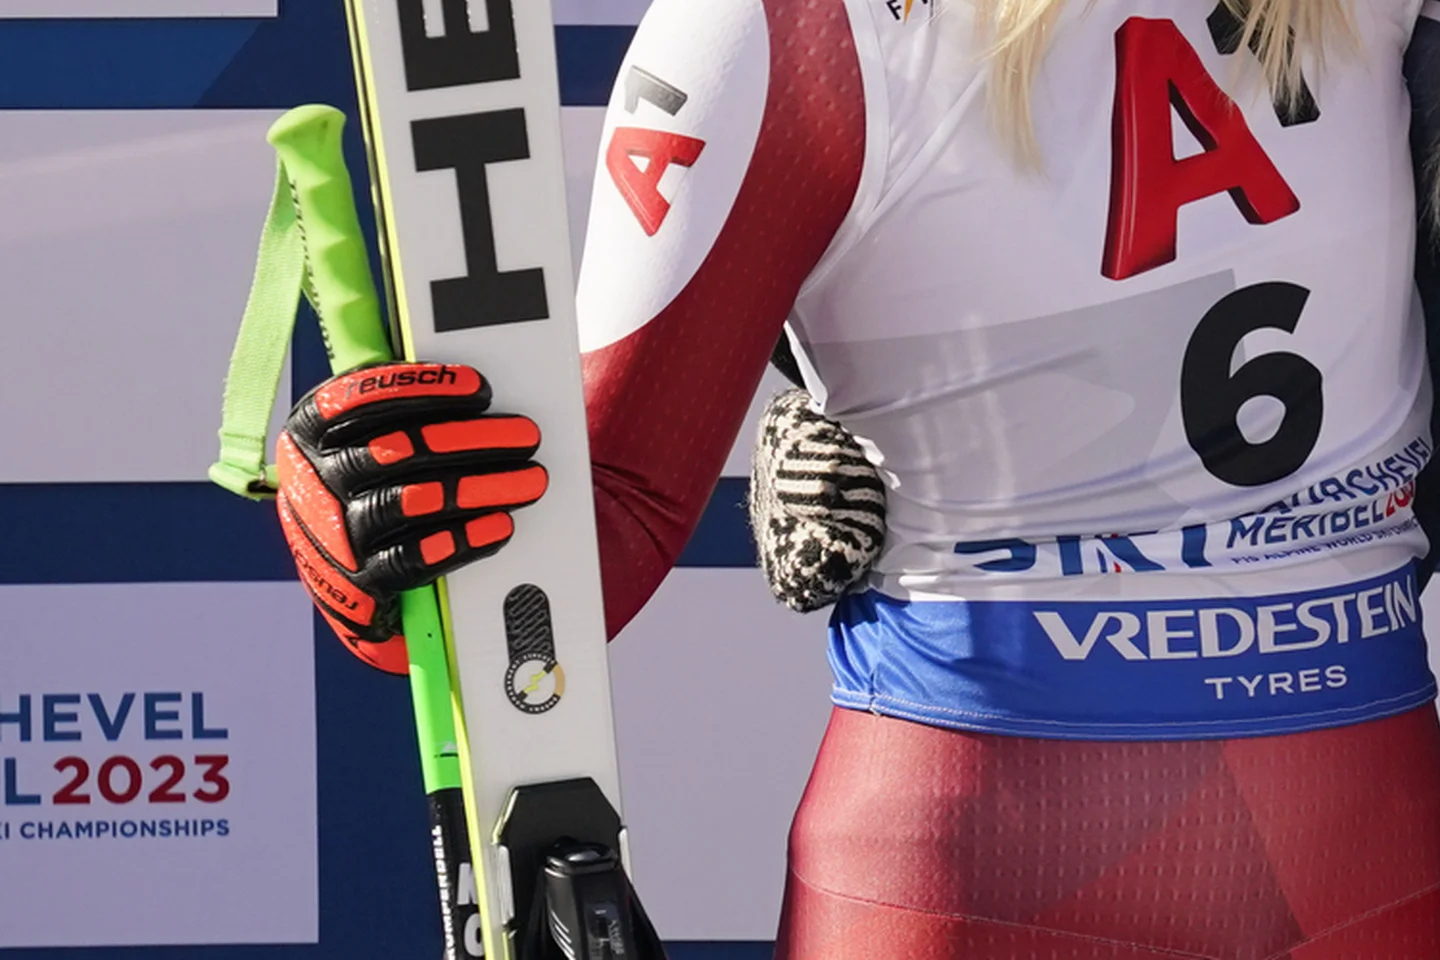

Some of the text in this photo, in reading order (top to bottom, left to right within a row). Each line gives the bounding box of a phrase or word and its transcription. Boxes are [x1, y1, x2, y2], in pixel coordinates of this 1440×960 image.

[346, 365, 456, 400] reusch
[1180, 280, 1324, 487] 6
[1033, 574, 1417, 661] VREDESTEIN
[1204, 665, 1348, 700] TYRES
[52, 754, 230, 806] 2023
[20, 819, 230, 839] CHAMPIONSHIPS
